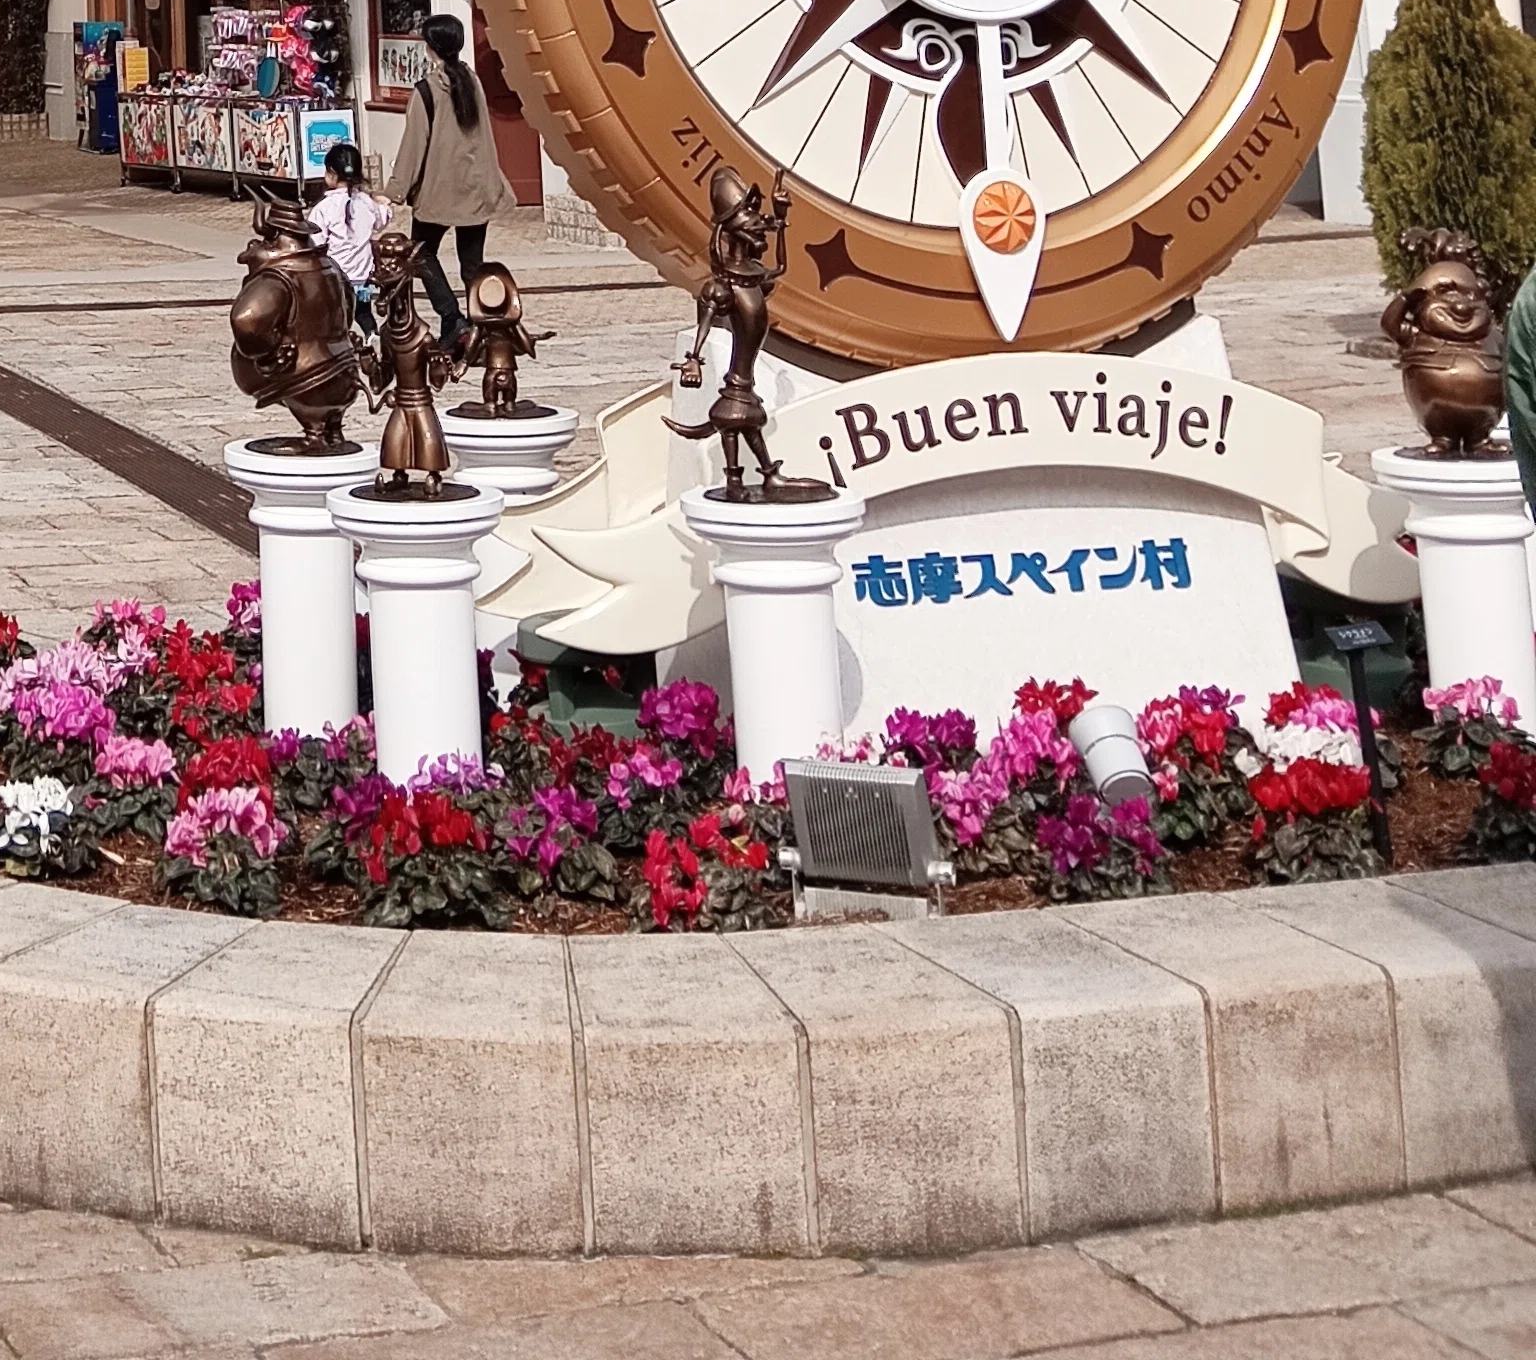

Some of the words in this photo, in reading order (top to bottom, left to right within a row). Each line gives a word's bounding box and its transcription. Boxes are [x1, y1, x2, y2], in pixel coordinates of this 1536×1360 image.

[671, 116, 734, 187] liz
[1187, 93, 1300, 222] Ánimo
[819, 388, 1029, 488] ¡Buen
[1050, 371, 1234, 459] viaje!
[851, 537, 1193, 607] 志摩スペイン村
